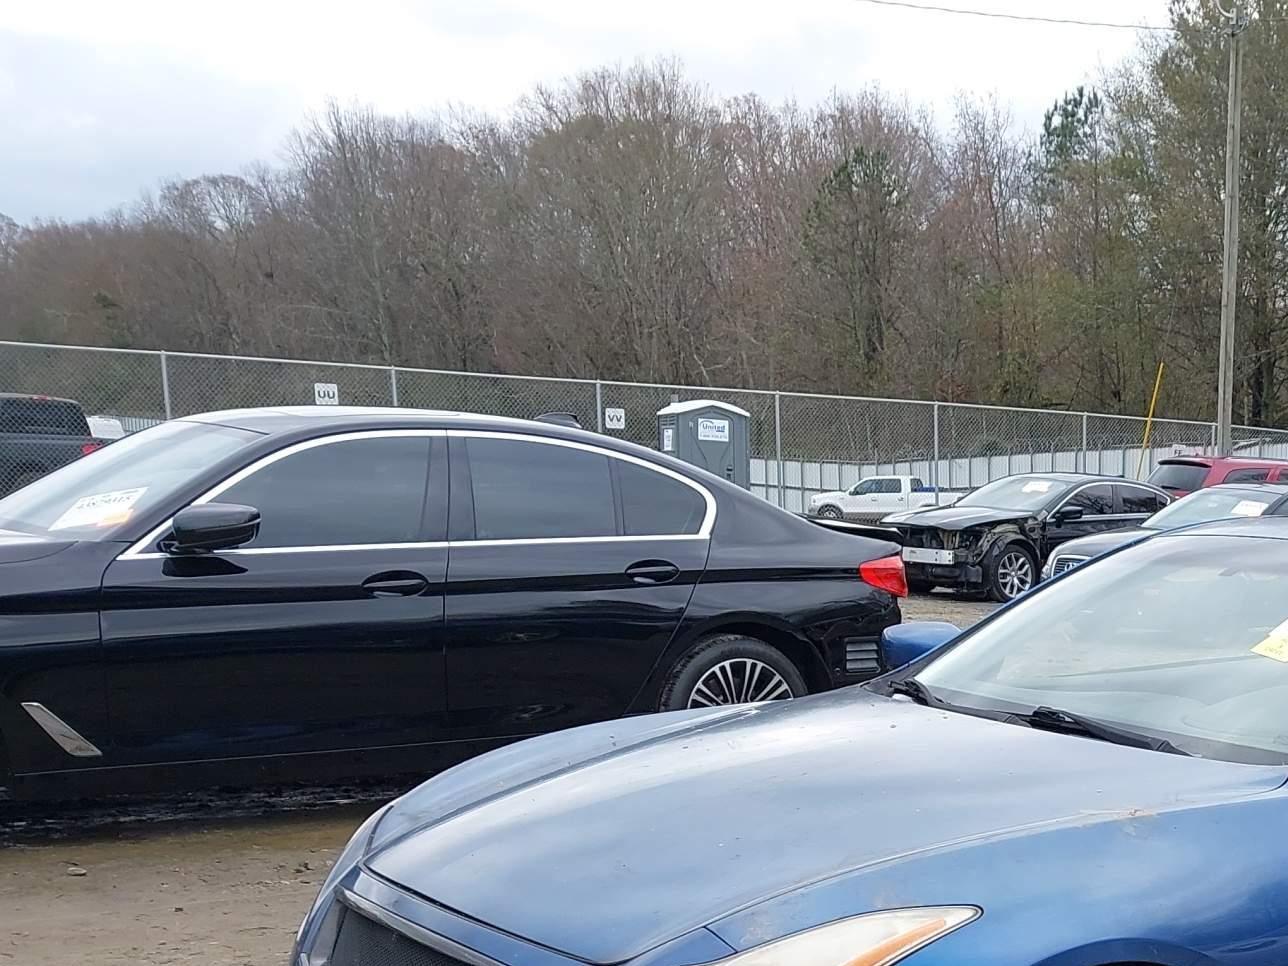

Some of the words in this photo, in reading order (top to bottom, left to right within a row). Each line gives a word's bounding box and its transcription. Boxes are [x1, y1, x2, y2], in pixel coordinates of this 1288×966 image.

[317, 389, 336, 400] UU
[607, 414, 622, 423] VV
[702, 423, 726, 432] United
